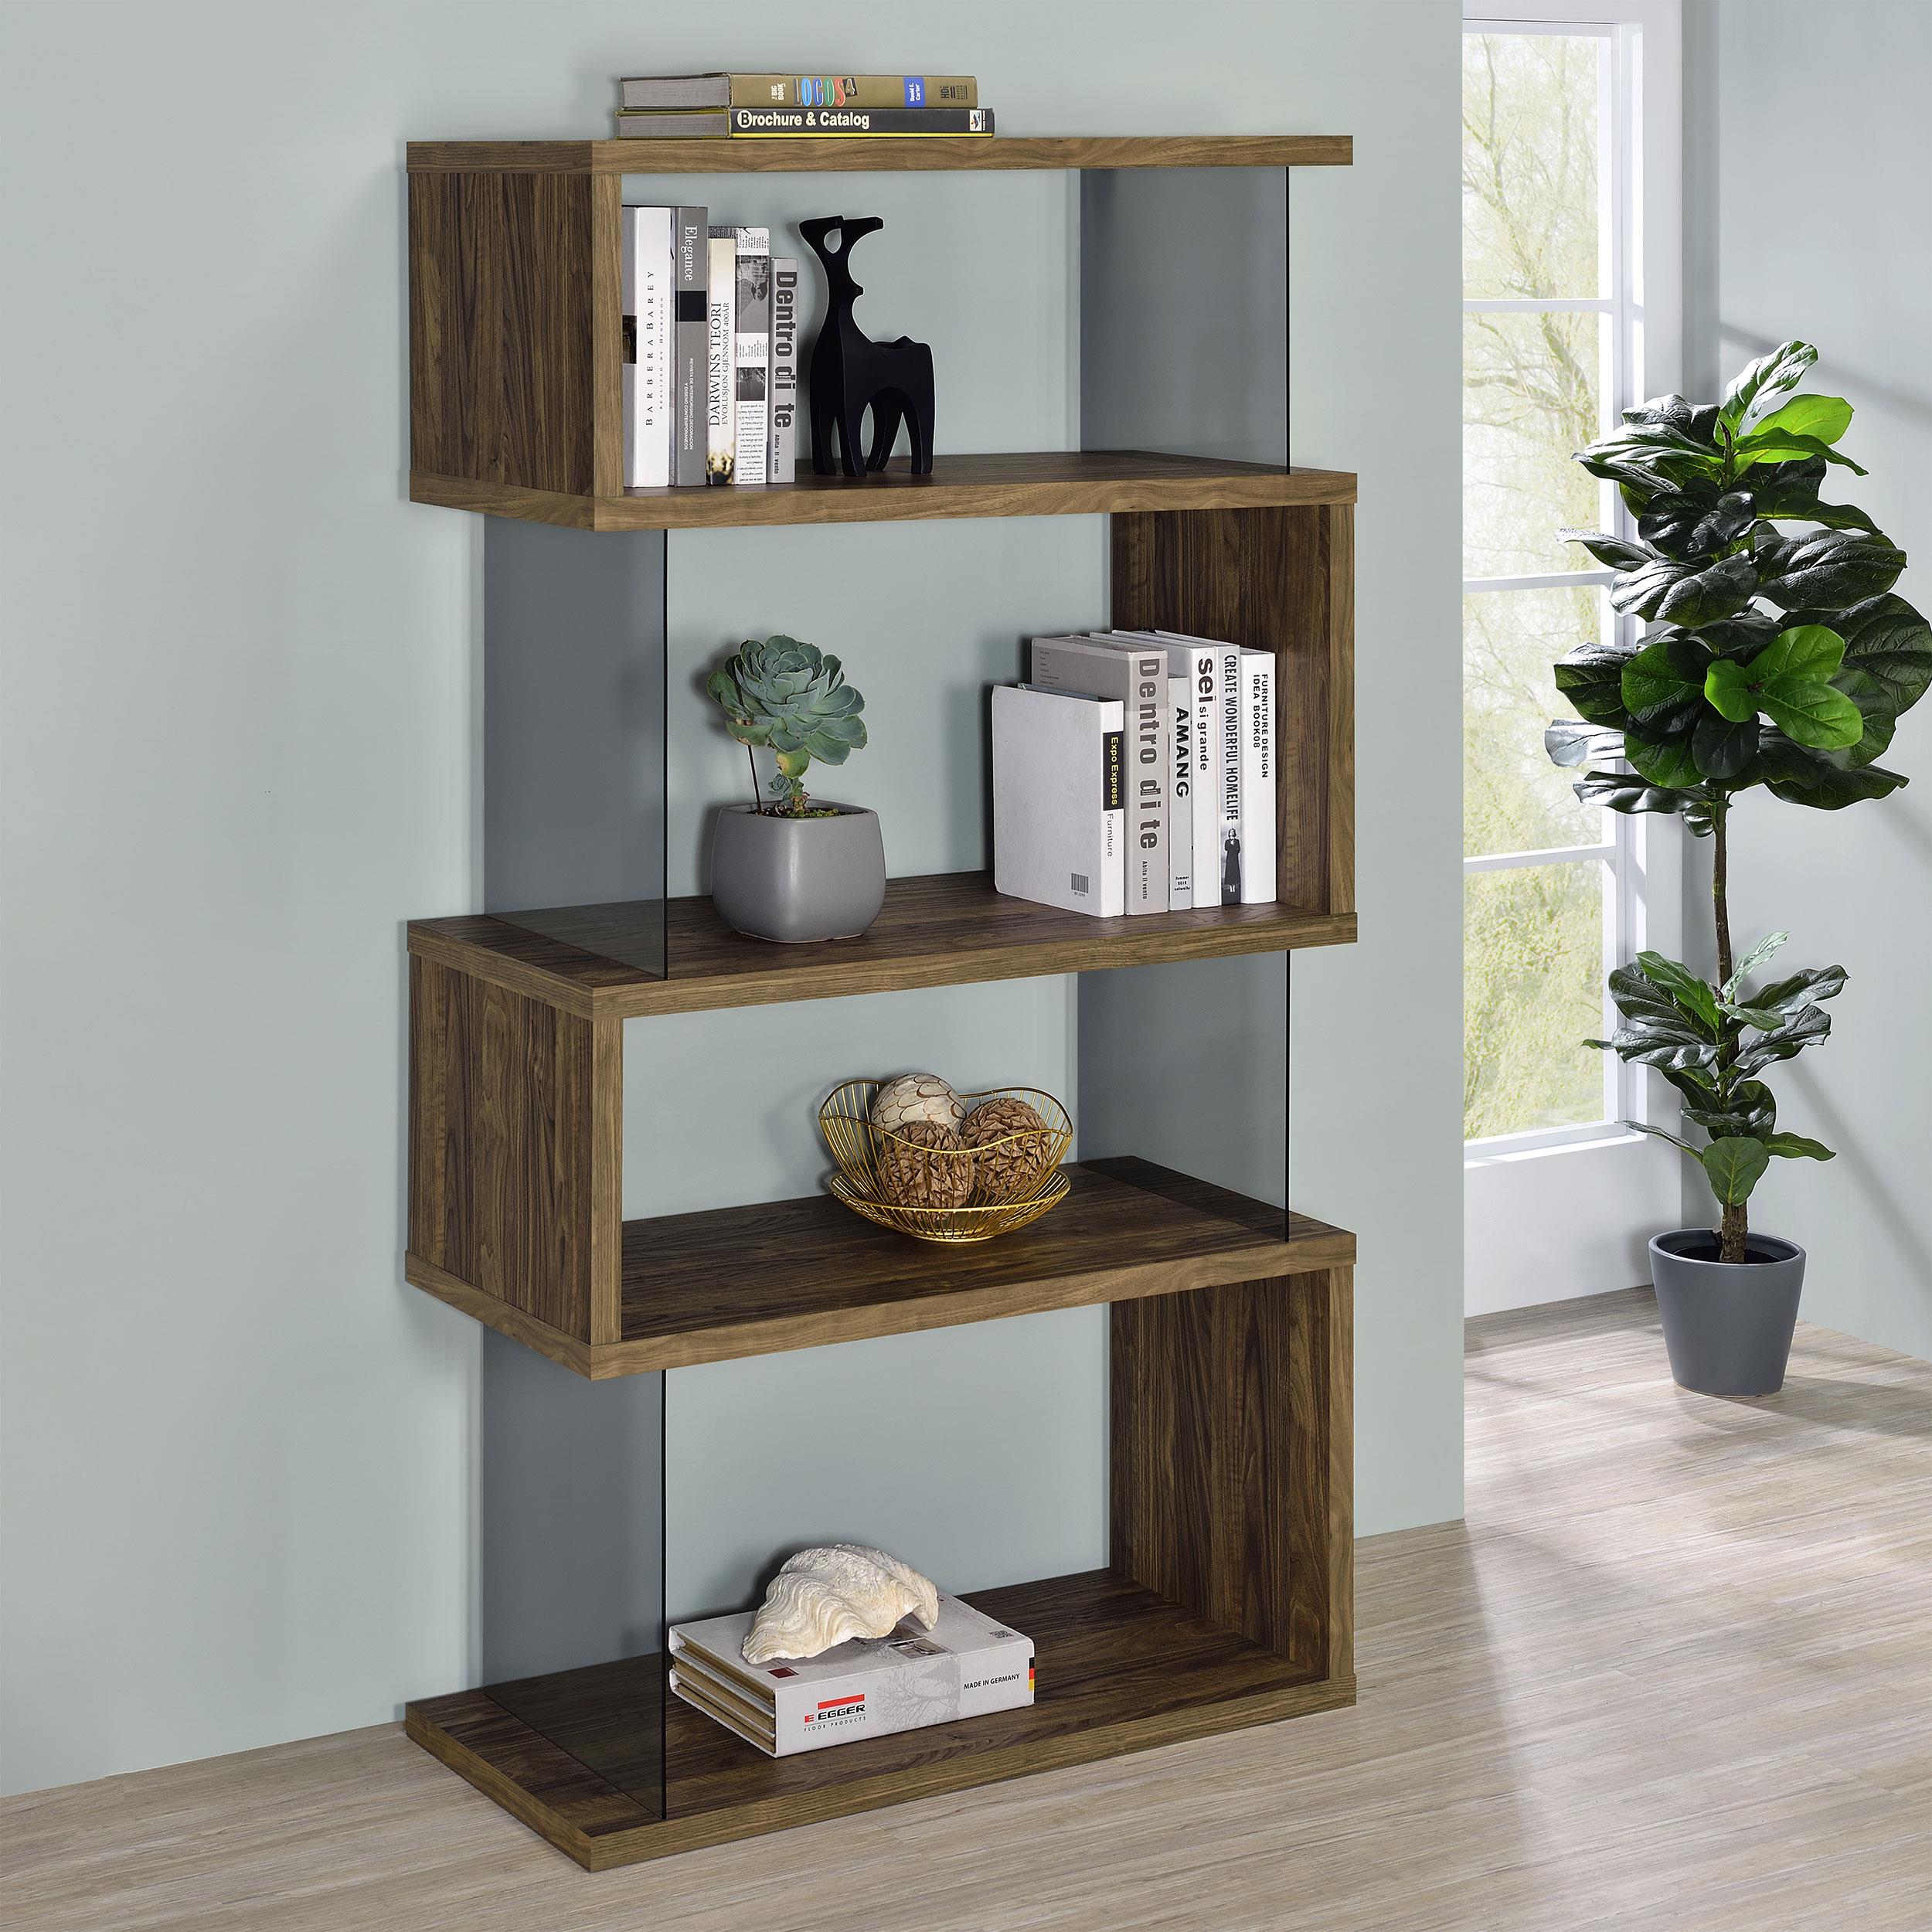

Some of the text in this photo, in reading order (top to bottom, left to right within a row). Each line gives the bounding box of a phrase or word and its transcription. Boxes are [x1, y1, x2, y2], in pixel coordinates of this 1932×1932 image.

[736, 110, 870, 130] Brochure & Catalog
[680, 225, 698, 281] Elegance
[774, 271, 797, 357] Dentro
[645, 271, 655, 426] BARBERA BAREY
[709, 302, 722, 427] DARWINS TEORI
[721, 374, 730, 425] EVOLUSJON
[774, 366, 796, 389] di
[774, 403, 794, 428] te
[1138, 658, 1160, 764] Dentro
[1197, 658, 1216, 770] sei si grande
[1175, 707, 1189, 798] AMANG
[1224, 655, 1239, 821] CREATE WONDERFUL HOMELIFE
[1110, 736, 1119, 805] Expo Express
[1140, 779, 1162, 809] di
[1139, 818, 1161, 849] te
[964, 1680, 981, 1690] MADE
[990, 1673, 1020, 1685] GERMANY
[818, 1704, 866, 1720] EGGER
[831, 1716, 866, 1727] PRODUCTS
